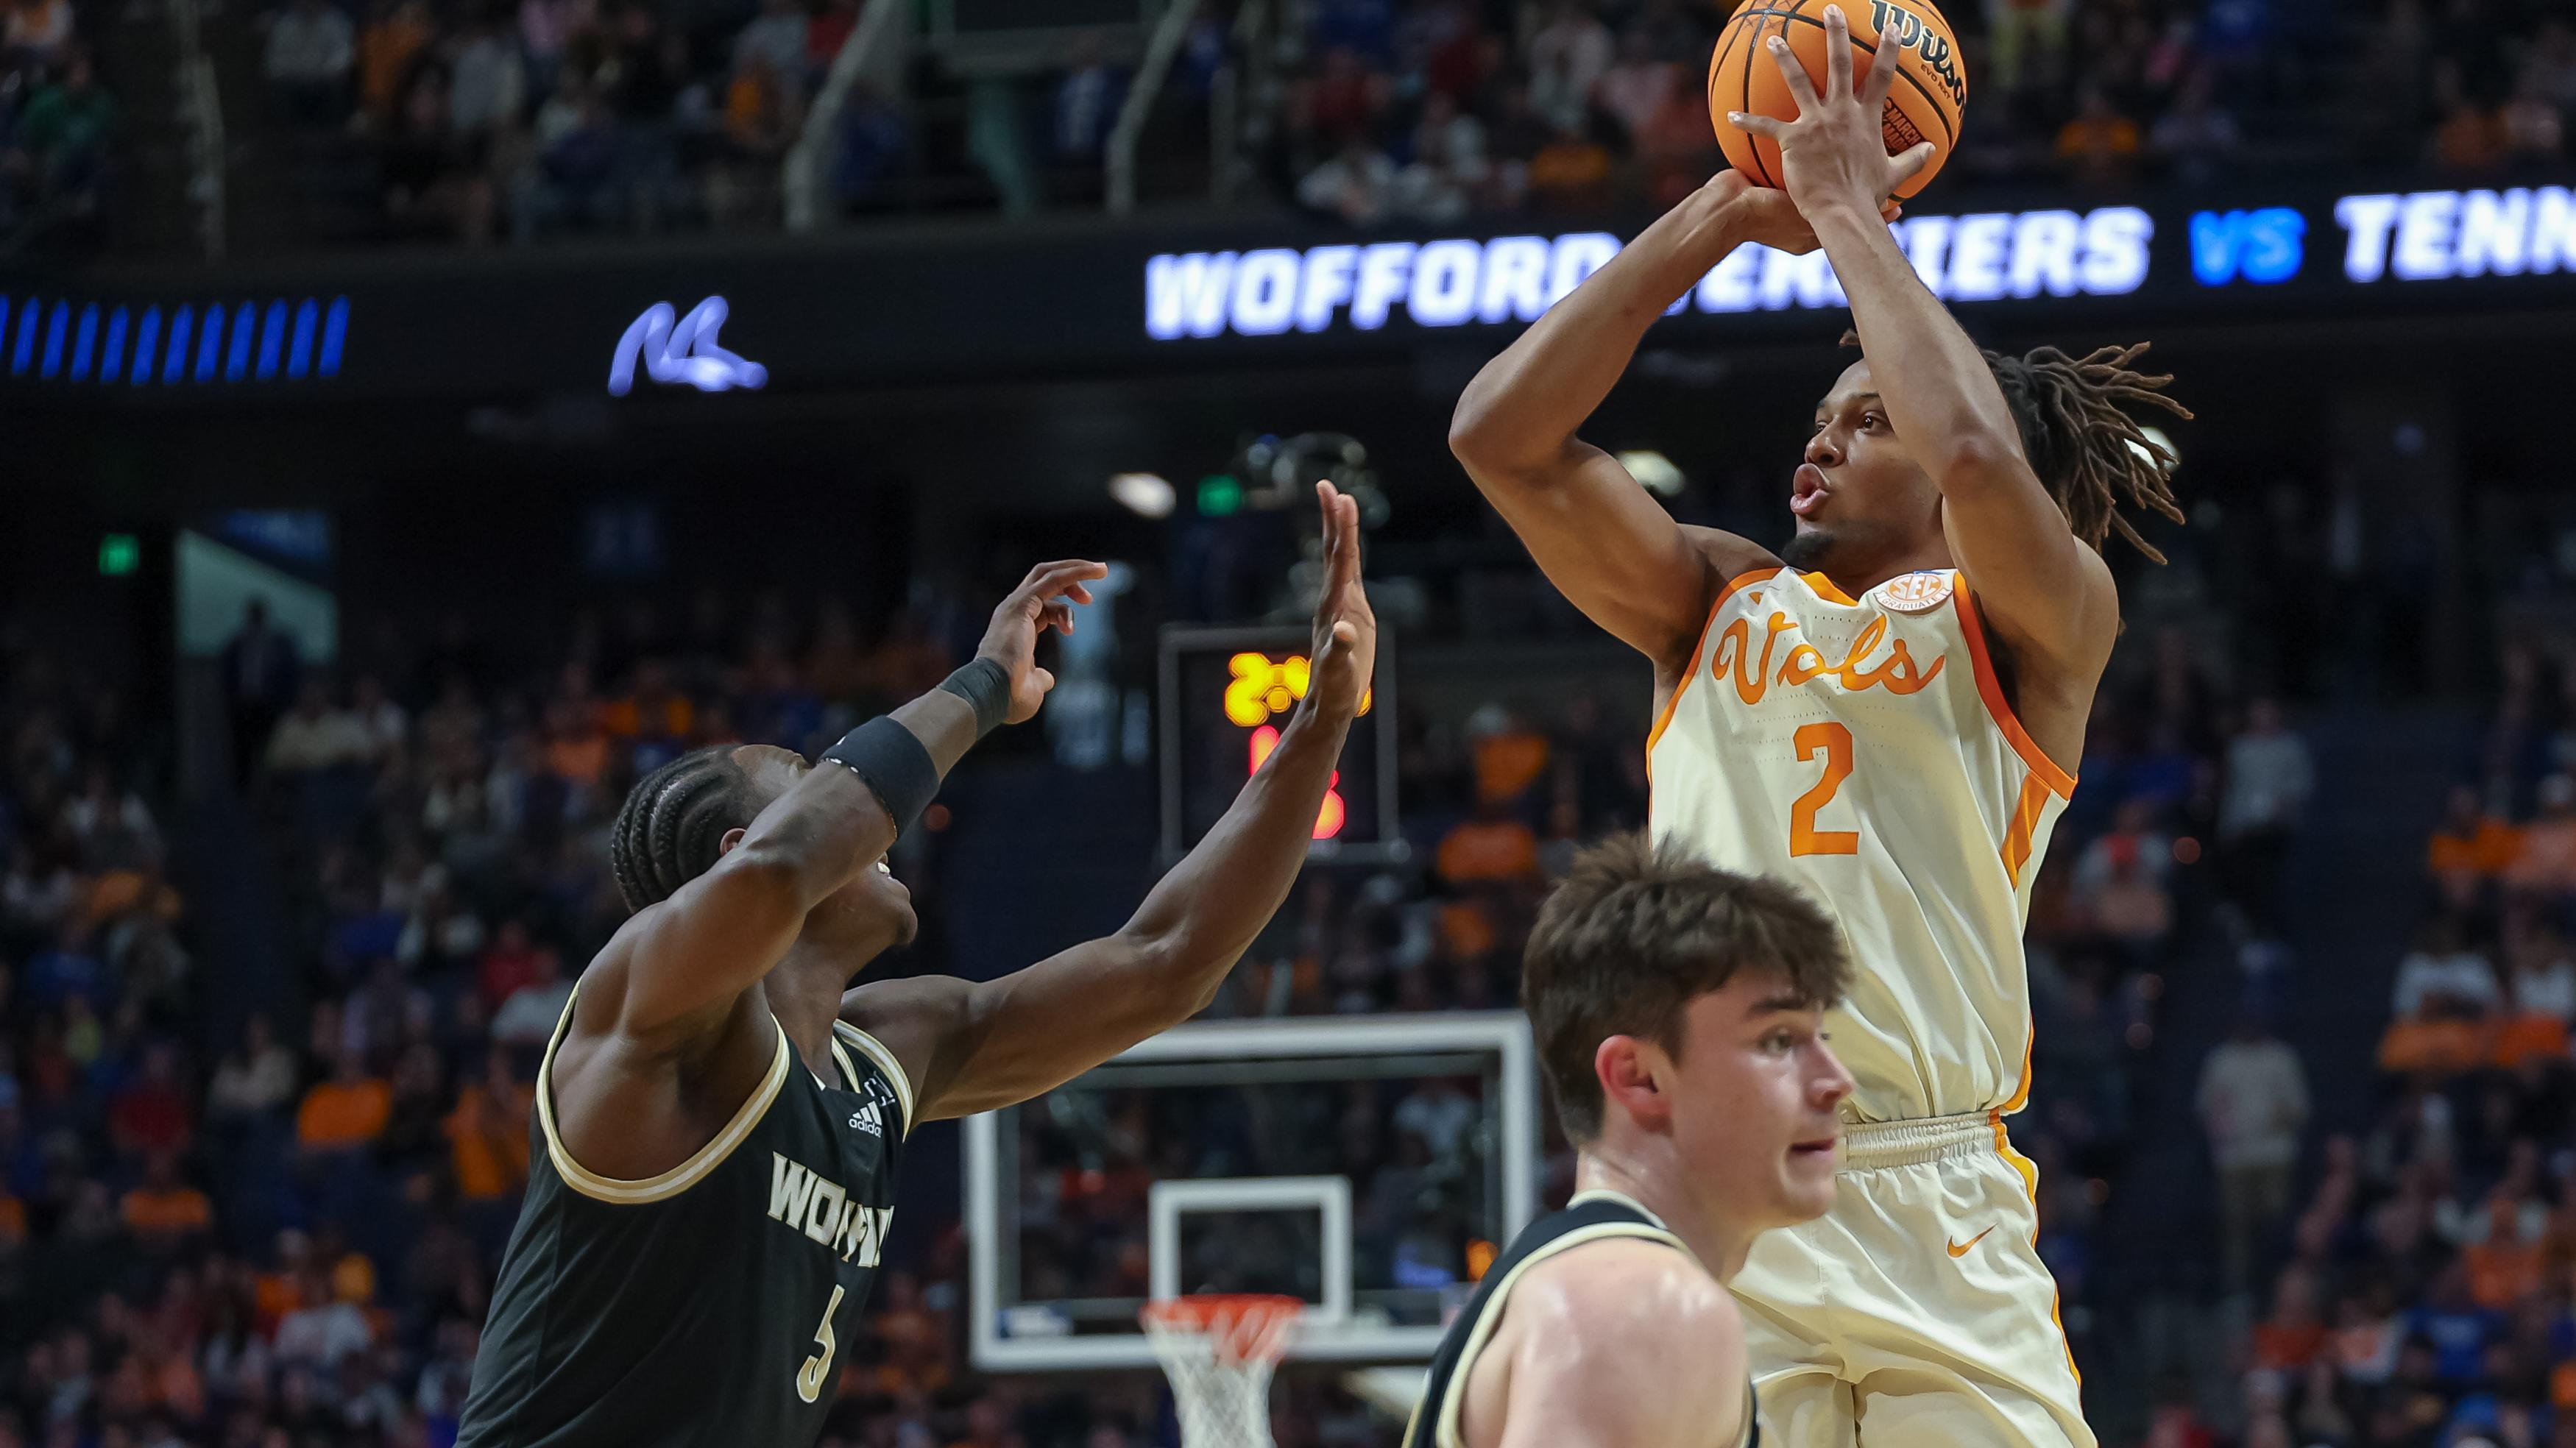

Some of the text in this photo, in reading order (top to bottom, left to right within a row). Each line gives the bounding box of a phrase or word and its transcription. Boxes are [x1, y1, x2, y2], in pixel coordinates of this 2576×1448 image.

[1921, 64, 1937, 82] EVO
[1886, 107, 1921, 146] MARCH
[1145, 185, 2576, 340] WOFFORD ERIERS VS TENN
[1882, 595, 1940, 610] GRADUATE
[1890, 575, 1940, 600] SEC
[1711, 611, 1945, 705] Vols
[1790, 722, 1859, 858] 2
[849, 1118, 882, 1138] adida
[796, 1283, 845, 1404] 5
